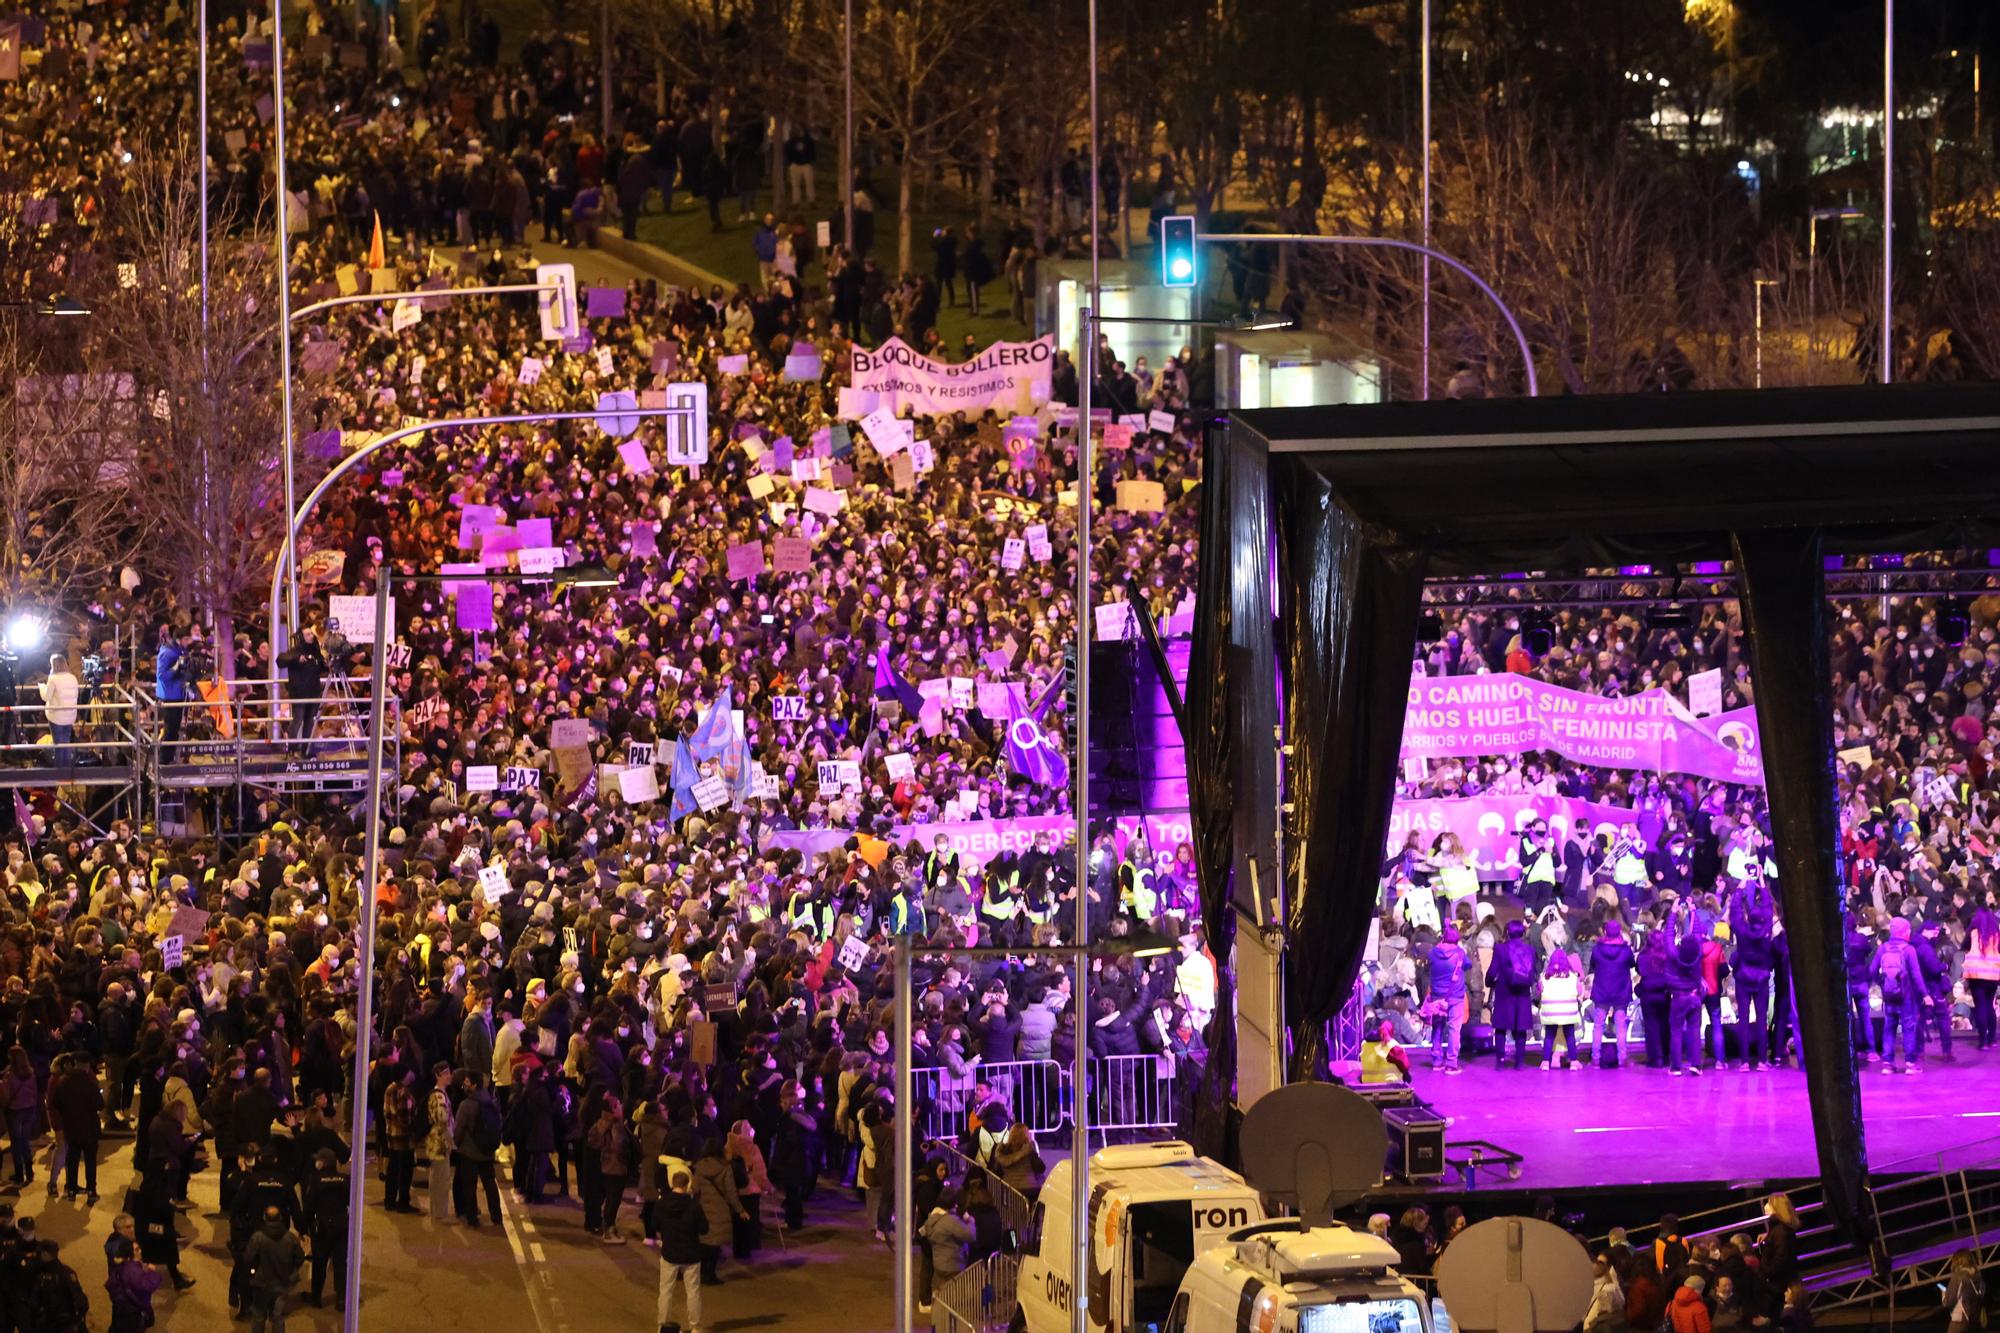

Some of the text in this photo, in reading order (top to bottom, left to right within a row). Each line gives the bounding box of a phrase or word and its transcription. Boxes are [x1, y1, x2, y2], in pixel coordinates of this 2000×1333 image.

[853, 343, 1050, 377] BLOQUE BOLLERO
[927, 385, 937, 396] Y
[939, 376, 1015, 398] RESISTIMOS
[415, 699, 440, 721] PAZ
[774, 697, 804, 719] PAZ
[1538, 693, 1578, 713] SIN
[1404, 709, 1461, 728] MOS
[1552, 718, 1678, 742] FEMINISTA
[1459, 734, 1469, 747] Y
[1473, 728, 1536, 747] PUEBLOS
[1557, 741, 1574, 755] DE
[1578, 745, 1636, 760] MADRID
[630, 746, 652, 766] PAZ
[1737, 753, 1758, 767] 8M
[508, 768, 539, 790] PAZ
[820, 764, 839, 785] PAZ
[1155, 824, 1193, 843] TO
[1194, 1206, 1248, 1229] ron
[1046, 1270, 1073, 1314] over
